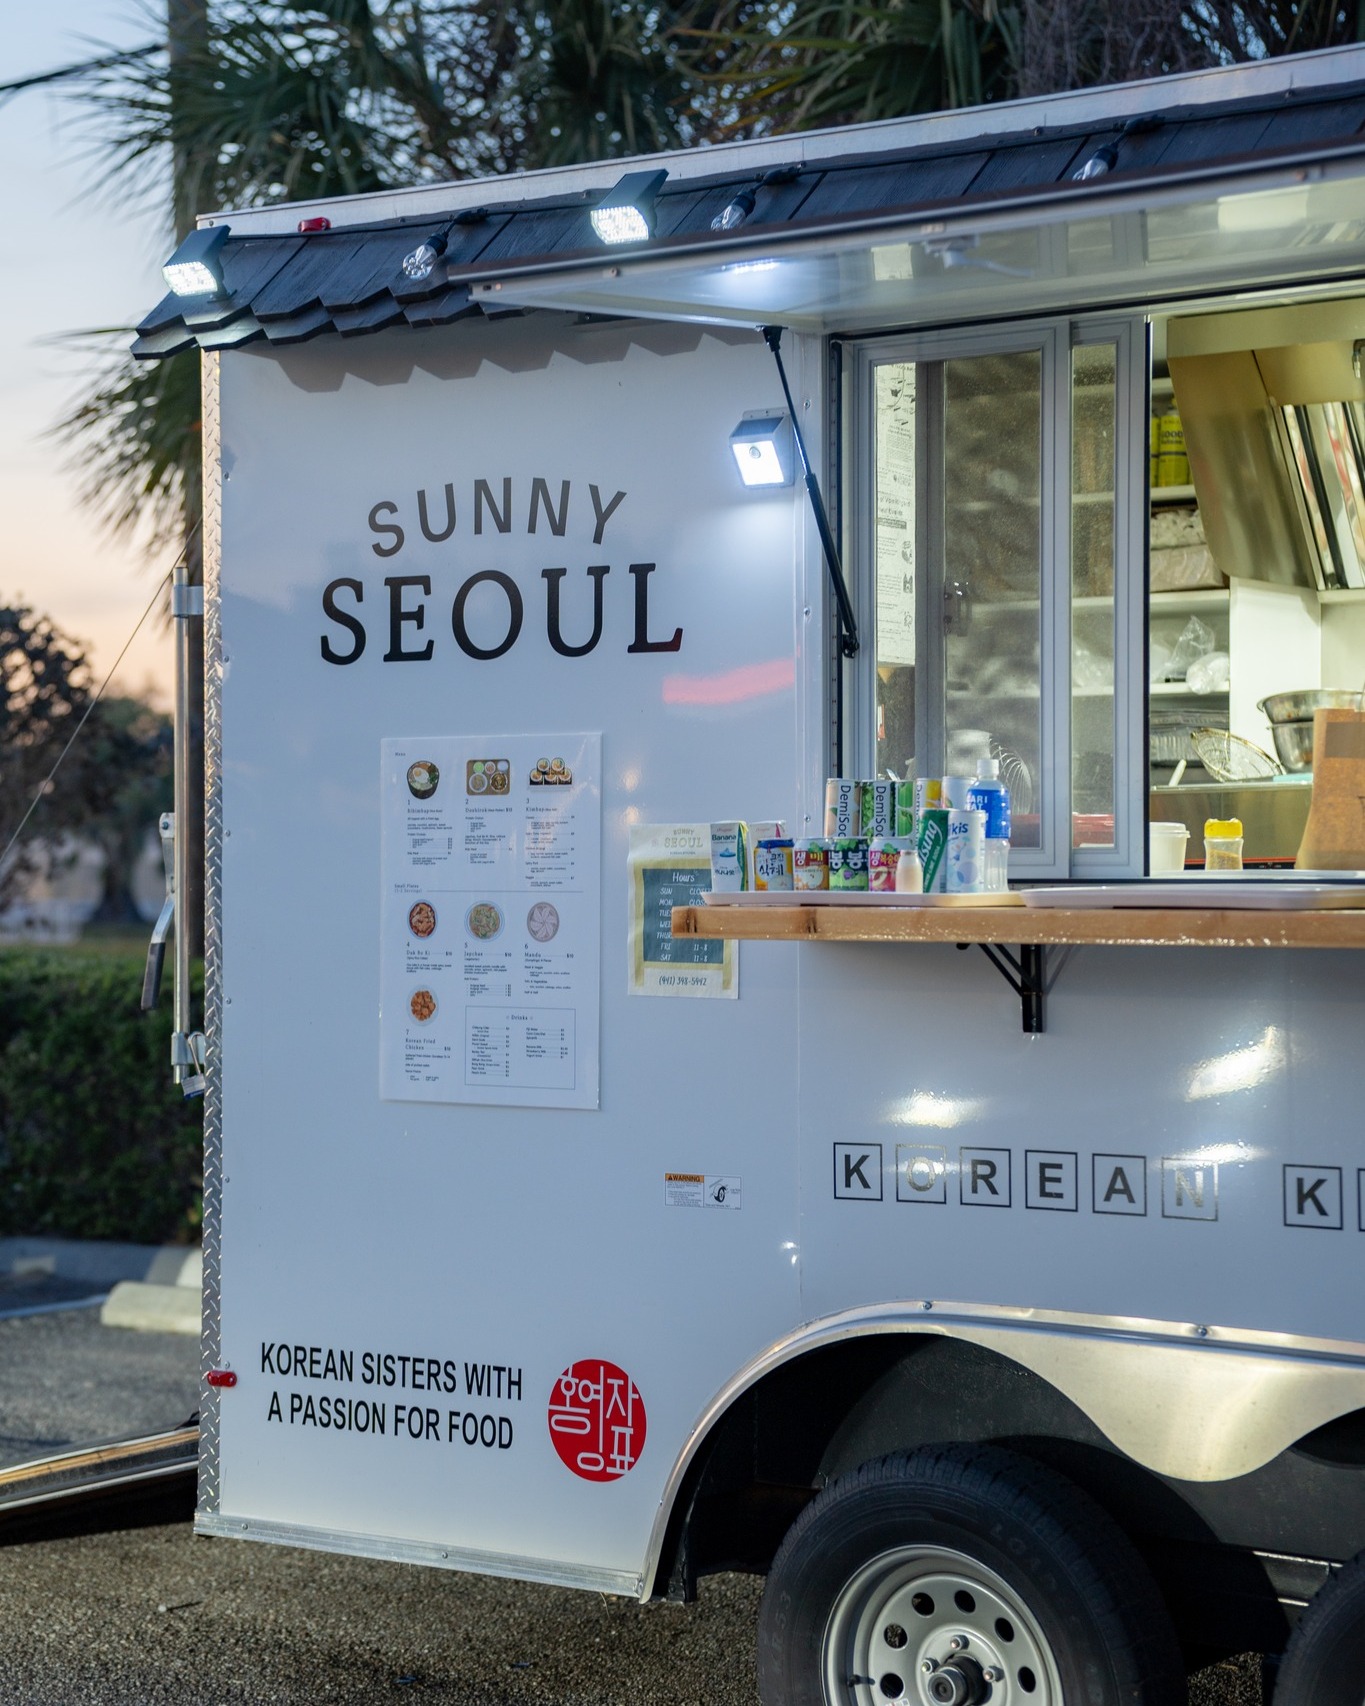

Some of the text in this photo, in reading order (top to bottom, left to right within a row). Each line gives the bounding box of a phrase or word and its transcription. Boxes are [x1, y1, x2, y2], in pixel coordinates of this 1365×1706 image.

[367, 476, 627, 557] SUNNY
[320, 562, 684, 666] SEOUL
[664, 837, 704, 848] SEOUL
[660, 887, 673, 895] SUN
[672, 872, 695, 882] Hours
[660, 942, 671, 950] FRI
[673, 1174, 700, 1183] WARNING
[843, 1153, 1330, 1217] KOREAN K
[261, 1342, 523, 1401] KOREAN SISTERS WITH
[268, 1391, 514, 1450] A PASSION FOR FOOD
